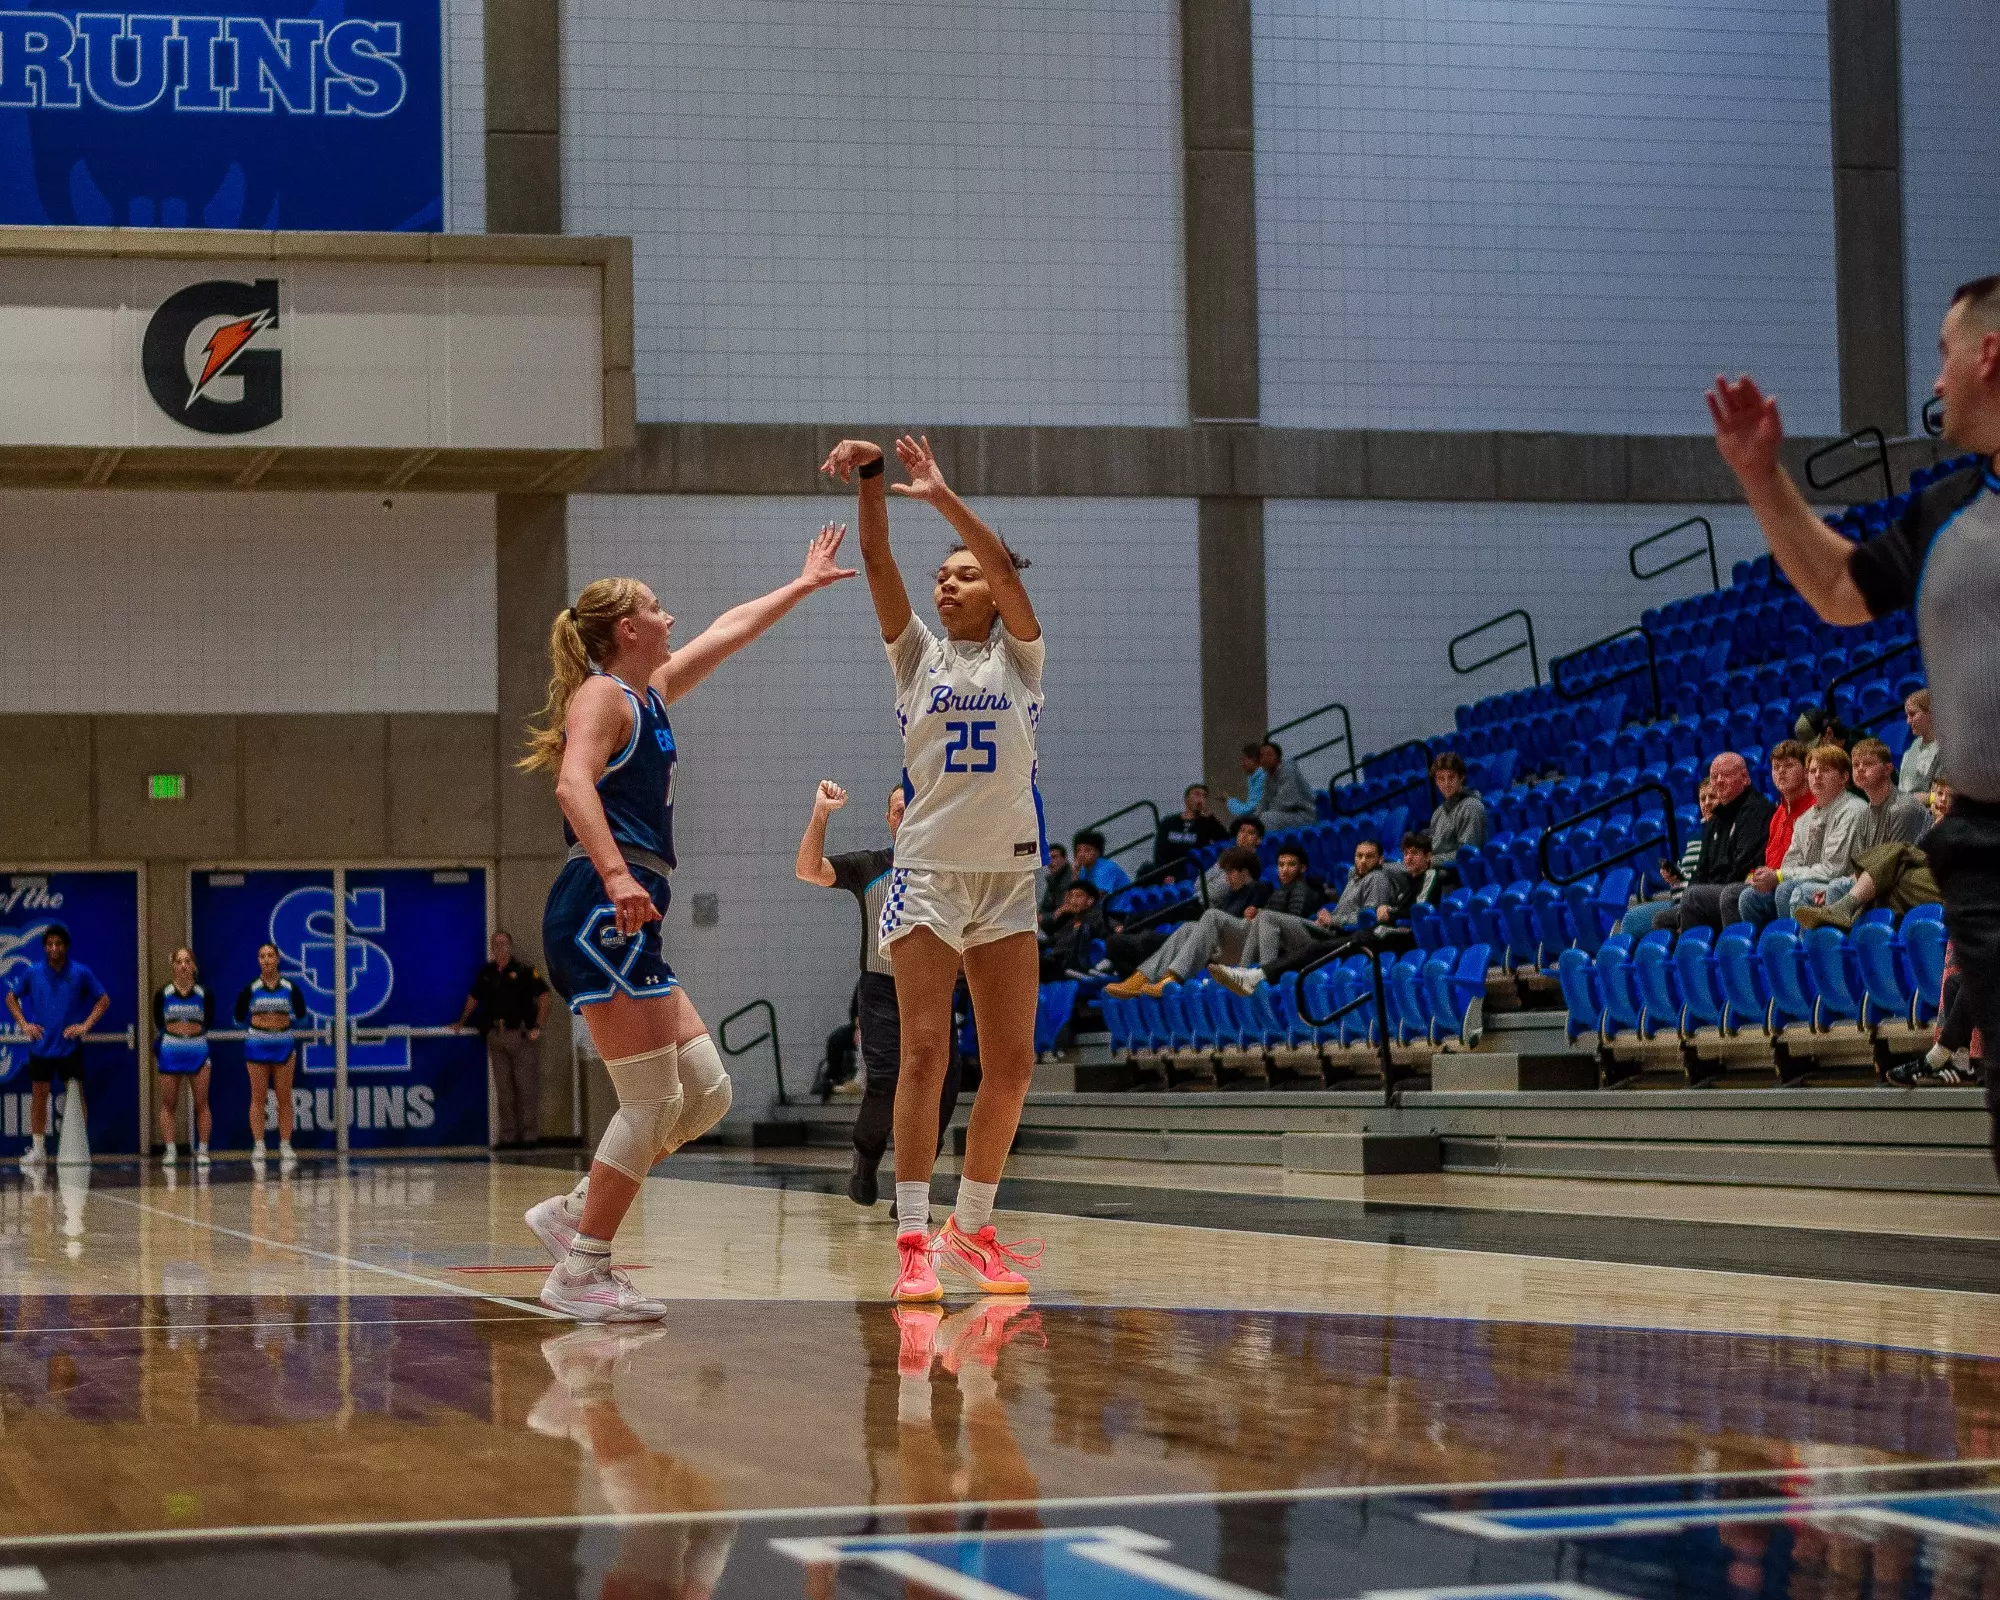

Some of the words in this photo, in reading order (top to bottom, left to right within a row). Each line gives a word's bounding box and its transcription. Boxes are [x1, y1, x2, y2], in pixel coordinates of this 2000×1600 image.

[0, 11, 407, 118] RUINS
[143, 278, 282, 434] G
[926, 684, 1012, 714] Bruins
[944, 721, 997, 773] 25
